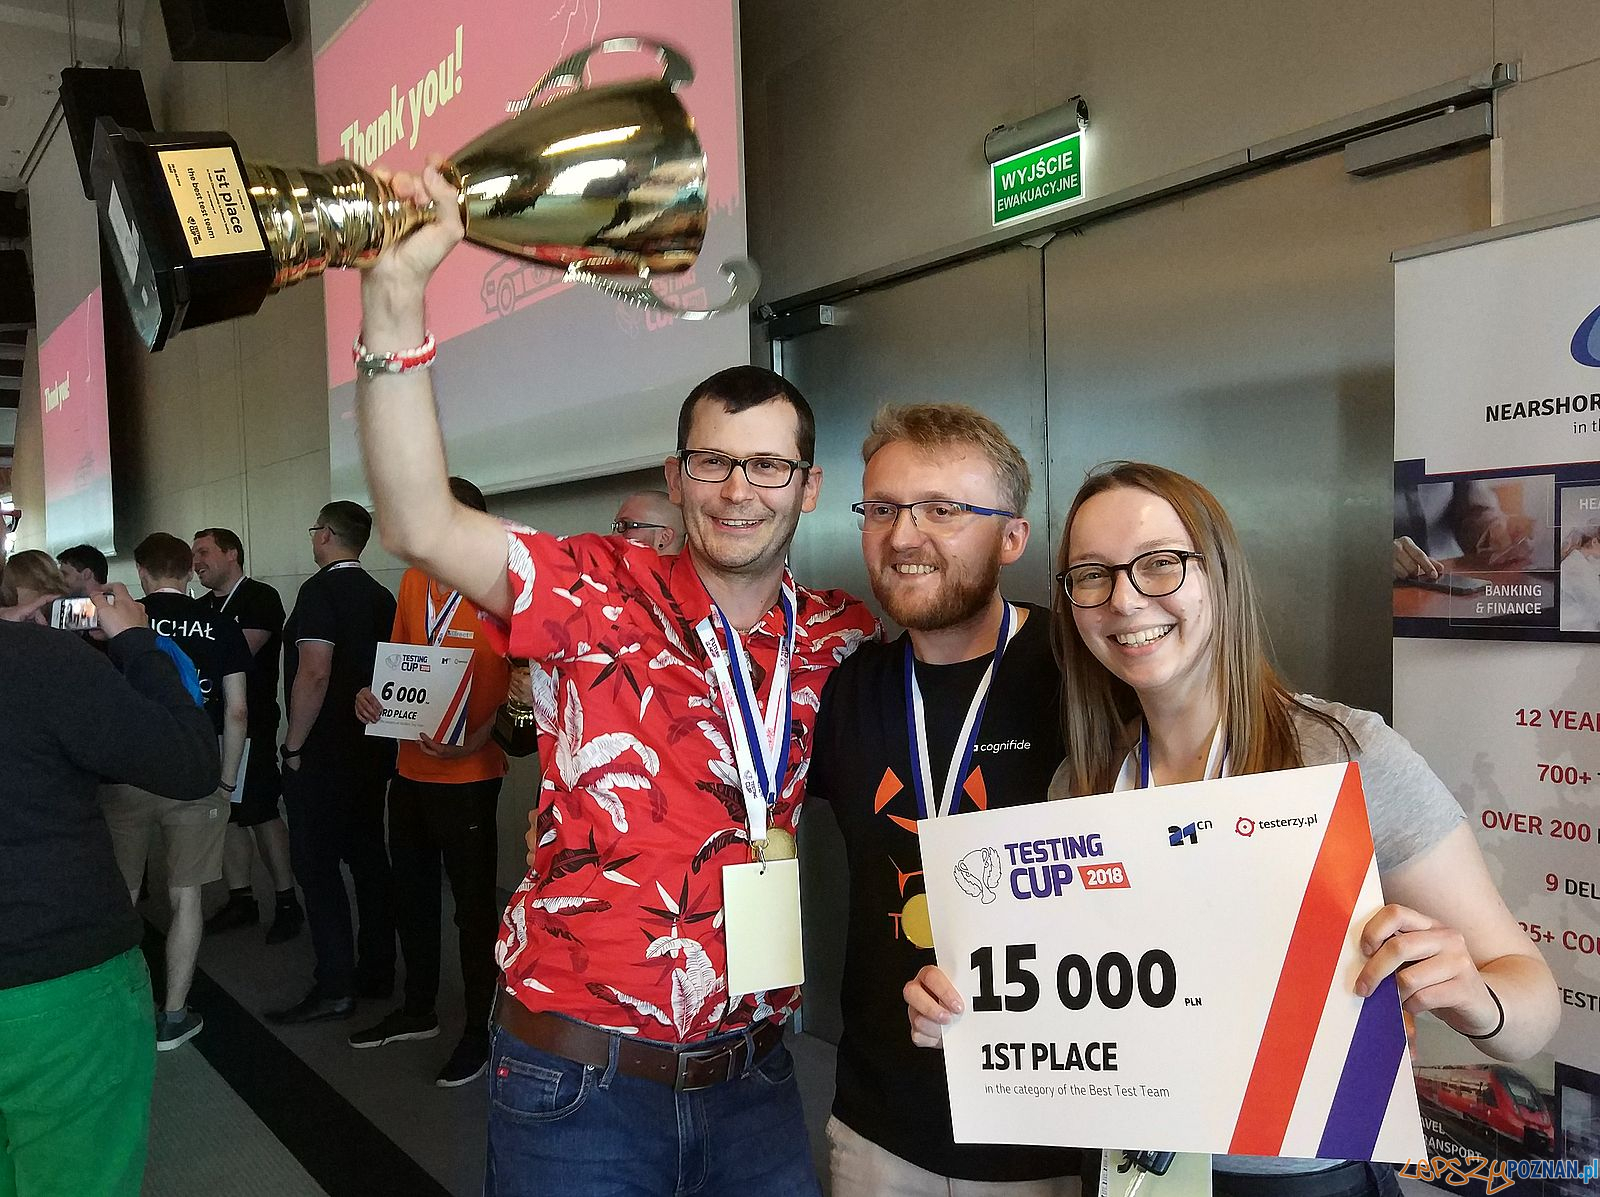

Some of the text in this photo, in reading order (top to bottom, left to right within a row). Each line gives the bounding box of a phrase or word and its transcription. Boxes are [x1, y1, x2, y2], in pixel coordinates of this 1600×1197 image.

[341, 24, 463, 167] Thank you!
[214, 168, 231, 188] 1st
[1001, 150, 1073, 190] WYJŚCIE
[187, 167, 196, 181] the
[192, 182, 203, 200] best
[198, 200, 209, 217] test
[204, 218, 215, 239] team
[998, 173, 1078, 212] EWAKUACYJNE
[219, 192, 243, 234] place
[1573, 421, 1587, 434] in
[1580, 497, 1600, 510] HE
[1485, 584, 1542, 597] BANKING
[1476, 602, 1542, 614] & FINANCE
[401, 662, 419, 672] CUP
[402, 654, 428, 663] TESTING
[381, 681, 427, 704] 6 000
[380, 708, 418, 720] RD PLACE
[1515, 708, 1600, 732] 12 YEA
[980, 739, 1031, 754] cognifide
[1537, 763, 1592, 785] 700+
[1258, 813, 1318, 830] testerzy.pl
[1481, 809, 1591, 842] OVER 200
[1004, 833, 1104, 866] TESTING
[1010, 863, 1124, 900] CUP 2018
[1545, 873, 1559, 892] 9
[1562, 930, 1600, 955] CO
[970, 943, 1203, 1012] 15 000 PLN
[1558, 986, 1600, 1013] EST
[981, 1041, 1118, 1072] 1ST PLACE
[984, 1083, 1170, 1098] in the category of the Best Test Team
